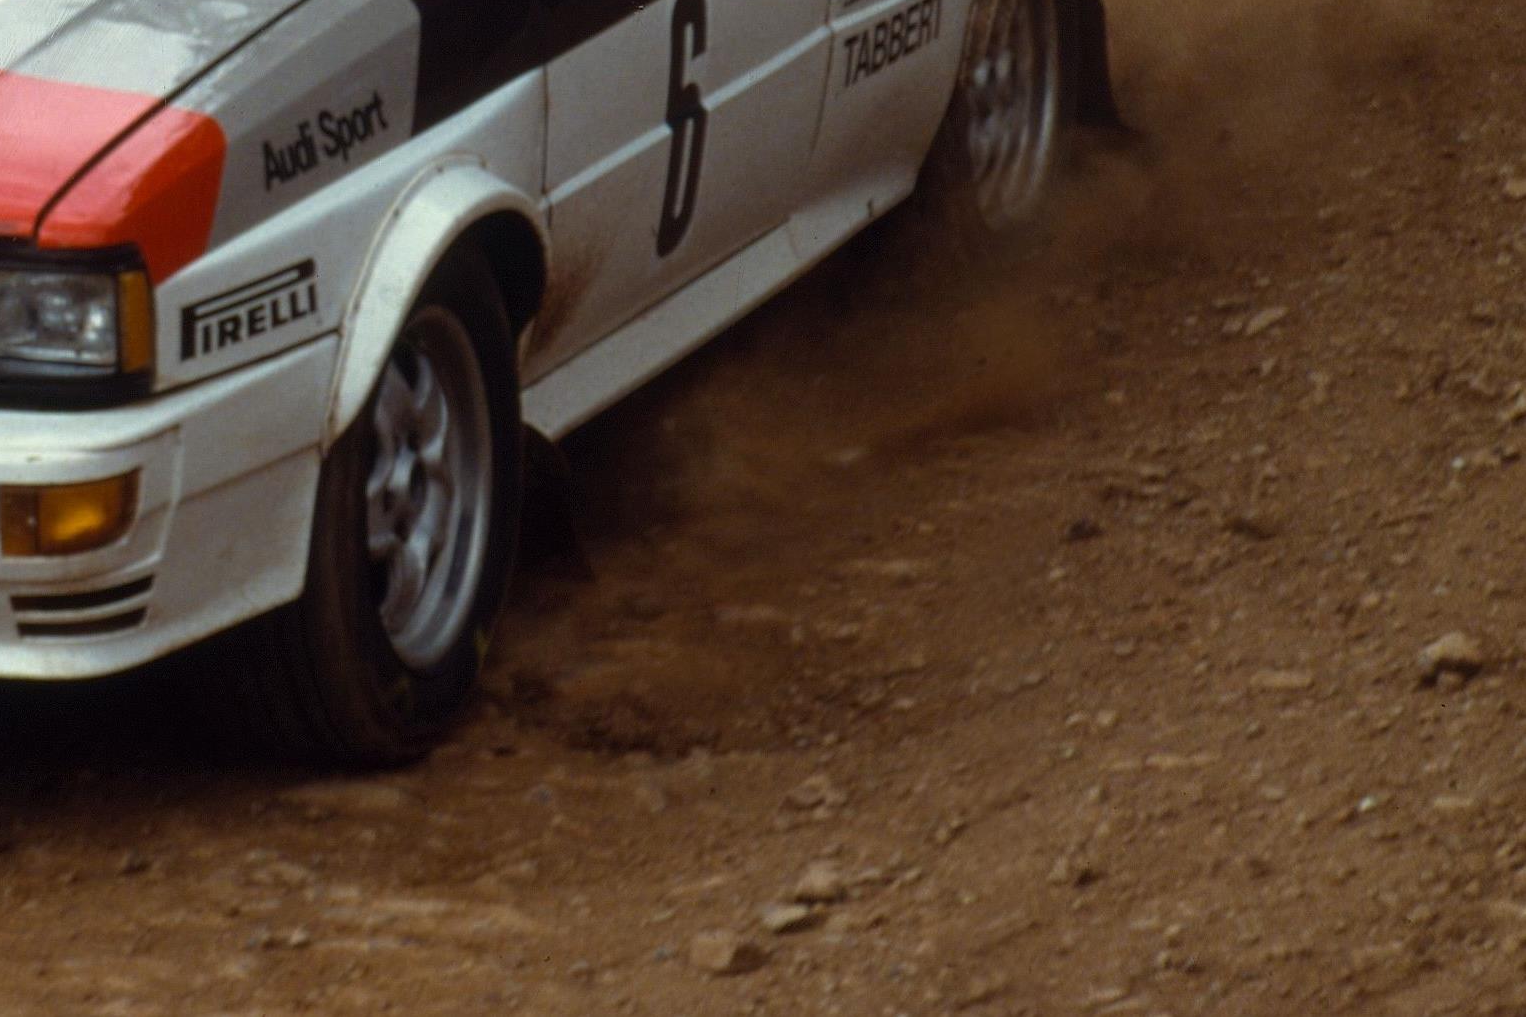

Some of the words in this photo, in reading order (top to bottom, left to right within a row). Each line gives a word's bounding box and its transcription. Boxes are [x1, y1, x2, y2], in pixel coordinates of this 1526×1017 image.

[261, 119, 319, 193] Audi
[318, 89, 389, 164] Sport
[179, 256, 318, 362] PIRELLI
